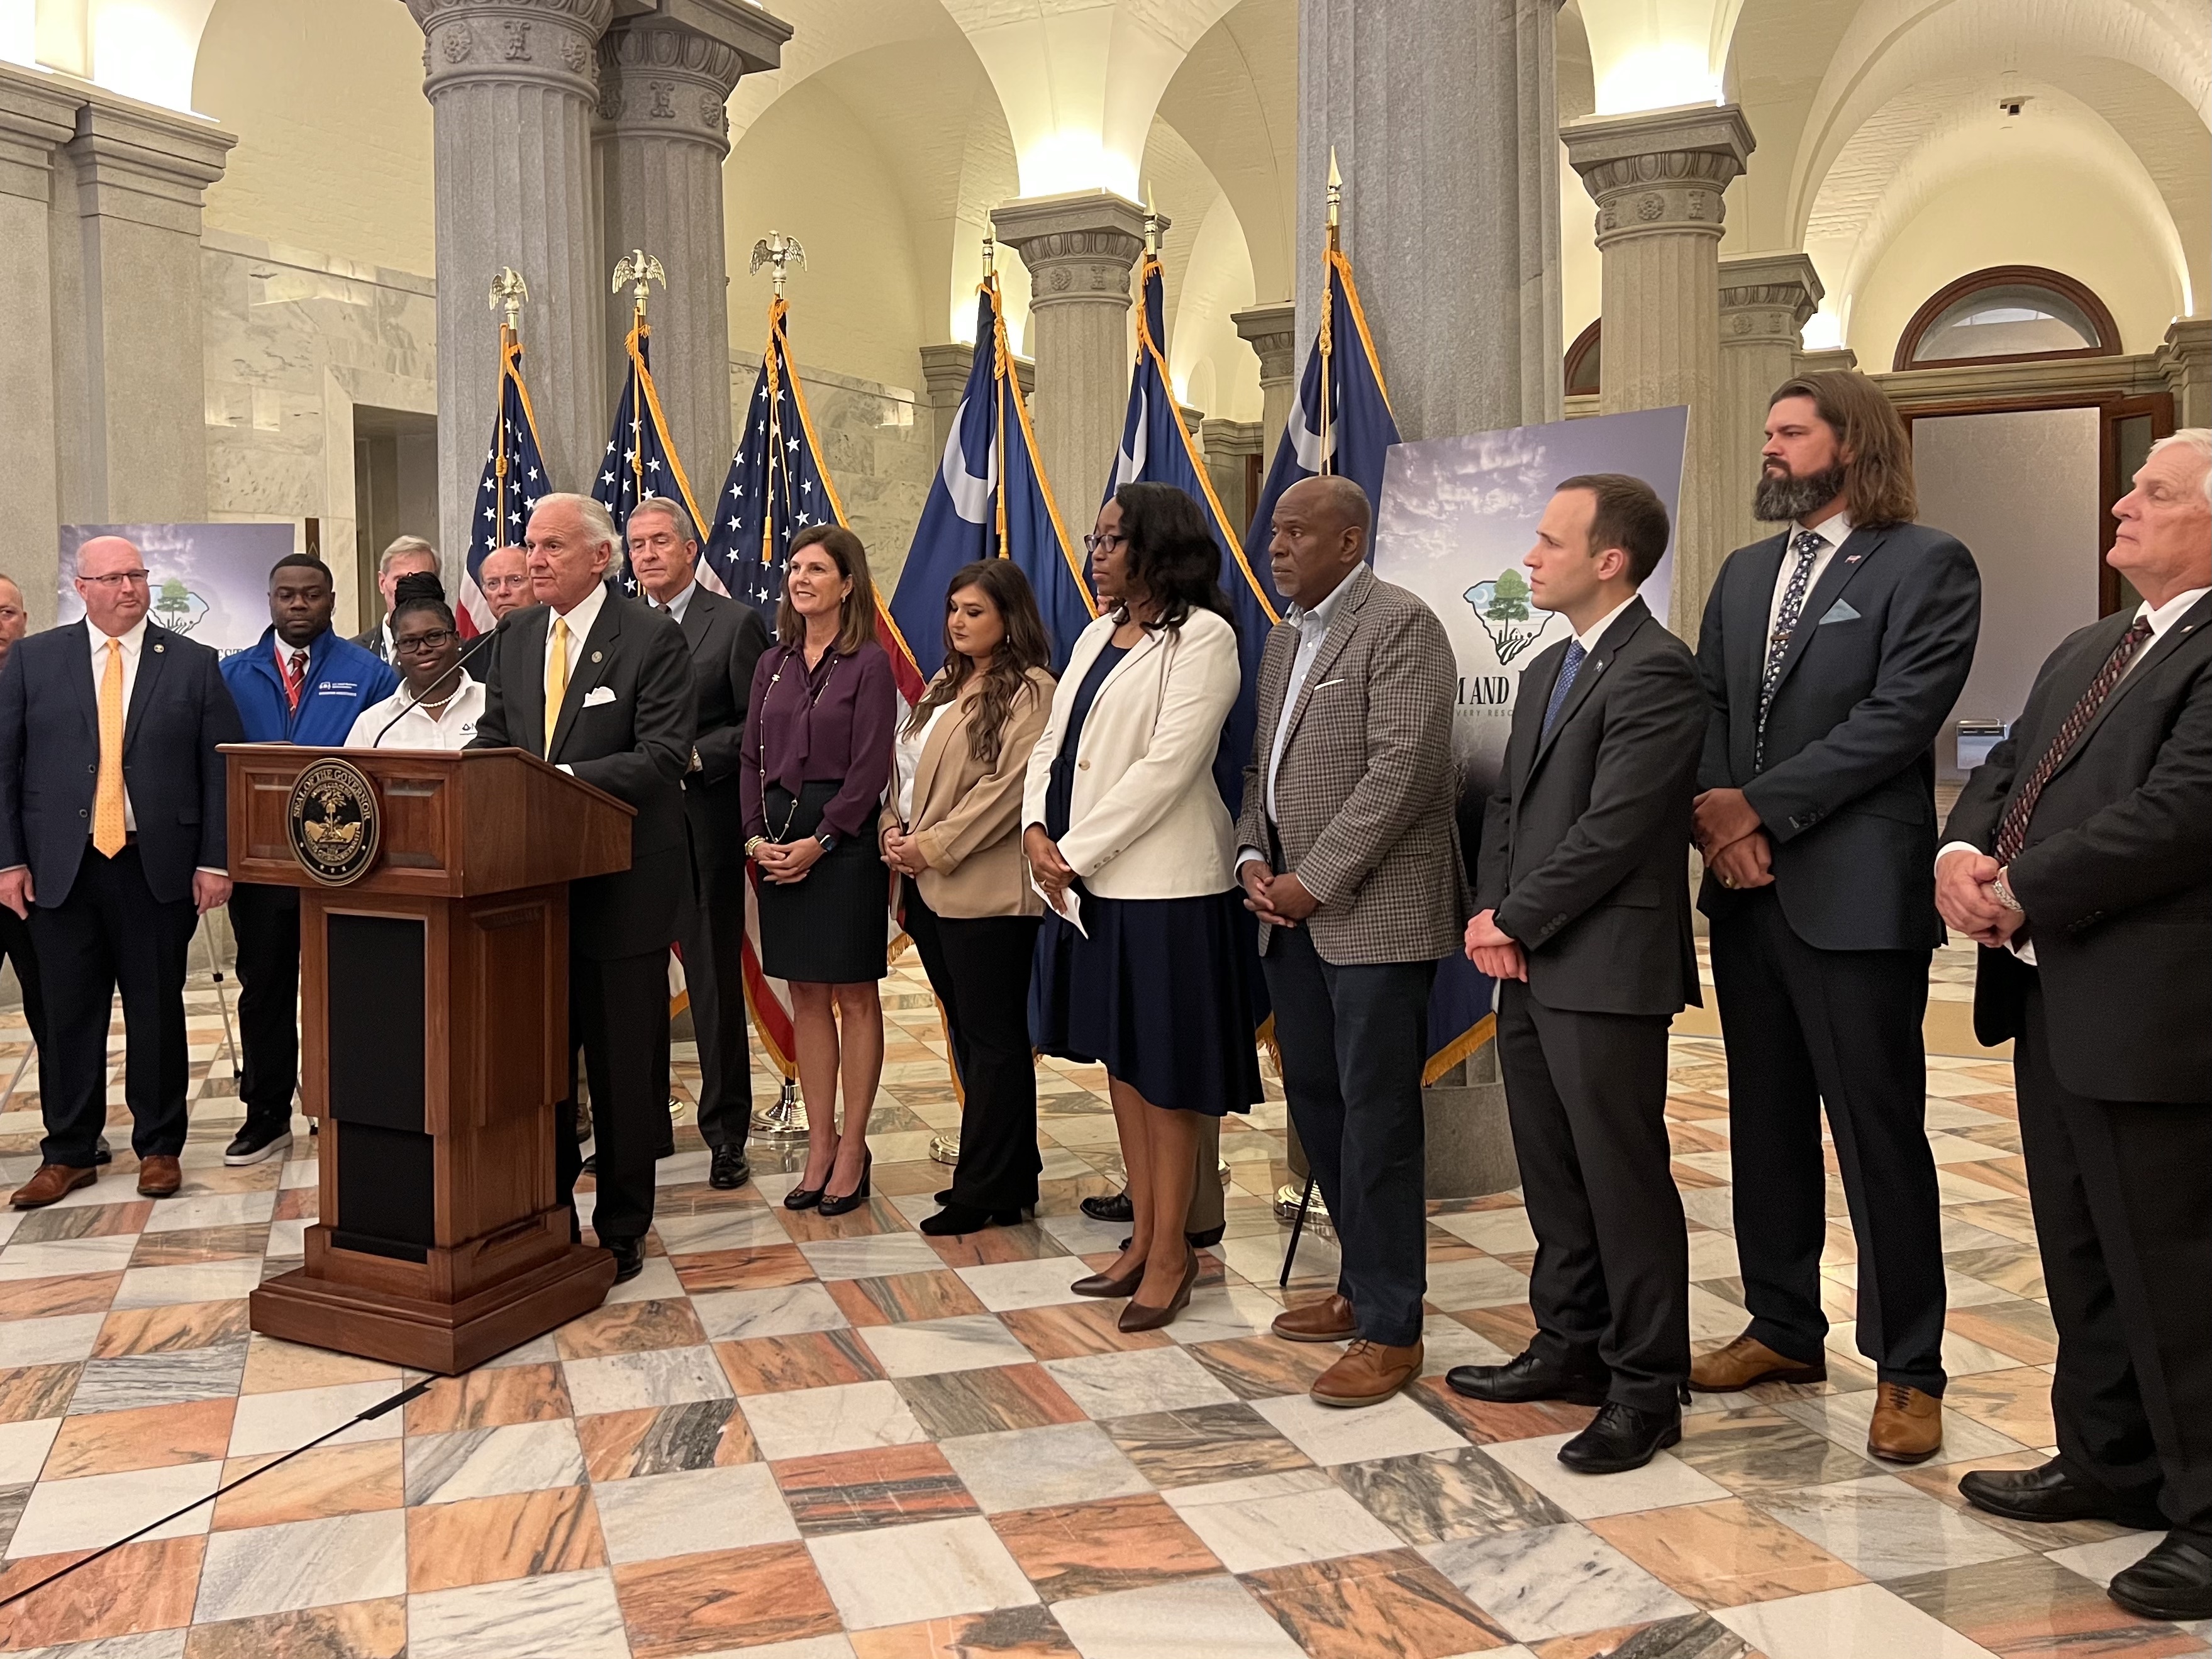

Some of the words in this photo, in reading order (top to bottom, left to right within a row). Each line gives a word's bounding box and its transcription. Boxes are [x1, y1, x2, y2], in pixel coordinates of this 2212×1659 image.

[1469, 676, 1509, 704] AND
[293, 789, 308, 818] SEAL
[303, 775, 315, 791] OF
[315, 769, 333, 782] THE
[334, 770, 370, 821] GOVERNOR
